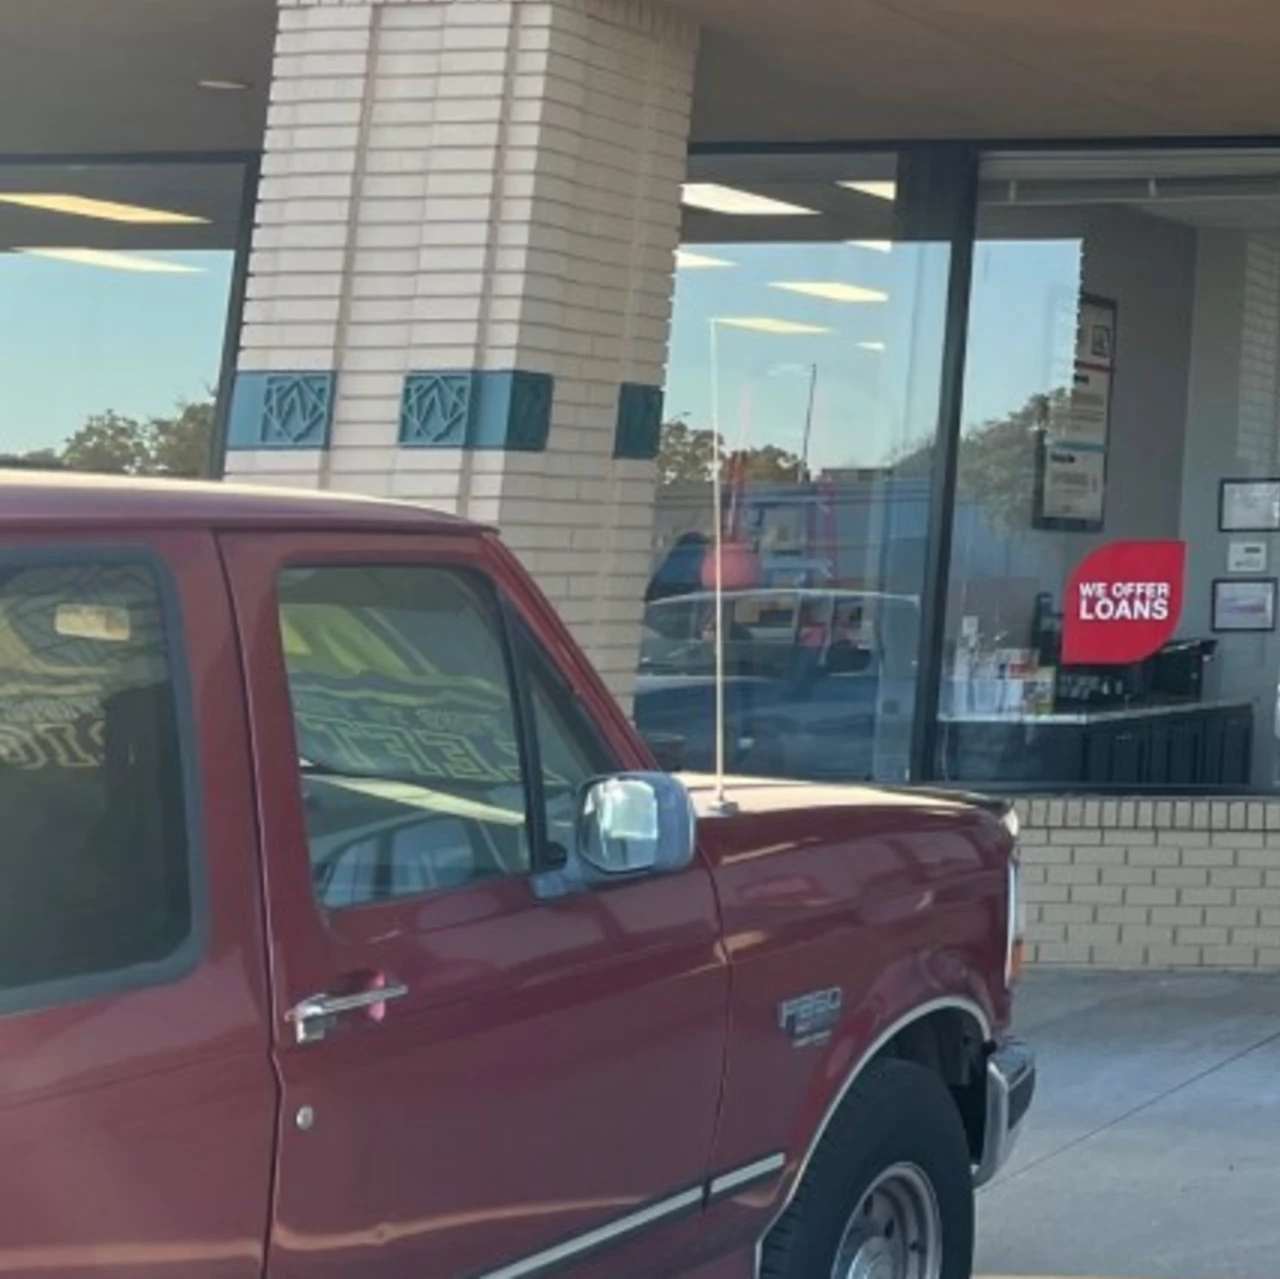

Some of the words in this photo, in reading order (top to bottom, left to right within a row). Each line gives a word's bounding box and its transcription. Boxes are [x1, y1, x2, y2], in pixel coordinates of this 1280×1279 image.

[1079, 582, 1108, 597] WE
[1112, 582, 1170, 598] OFFER
[1079, 599, 1168, 620] LOANS
